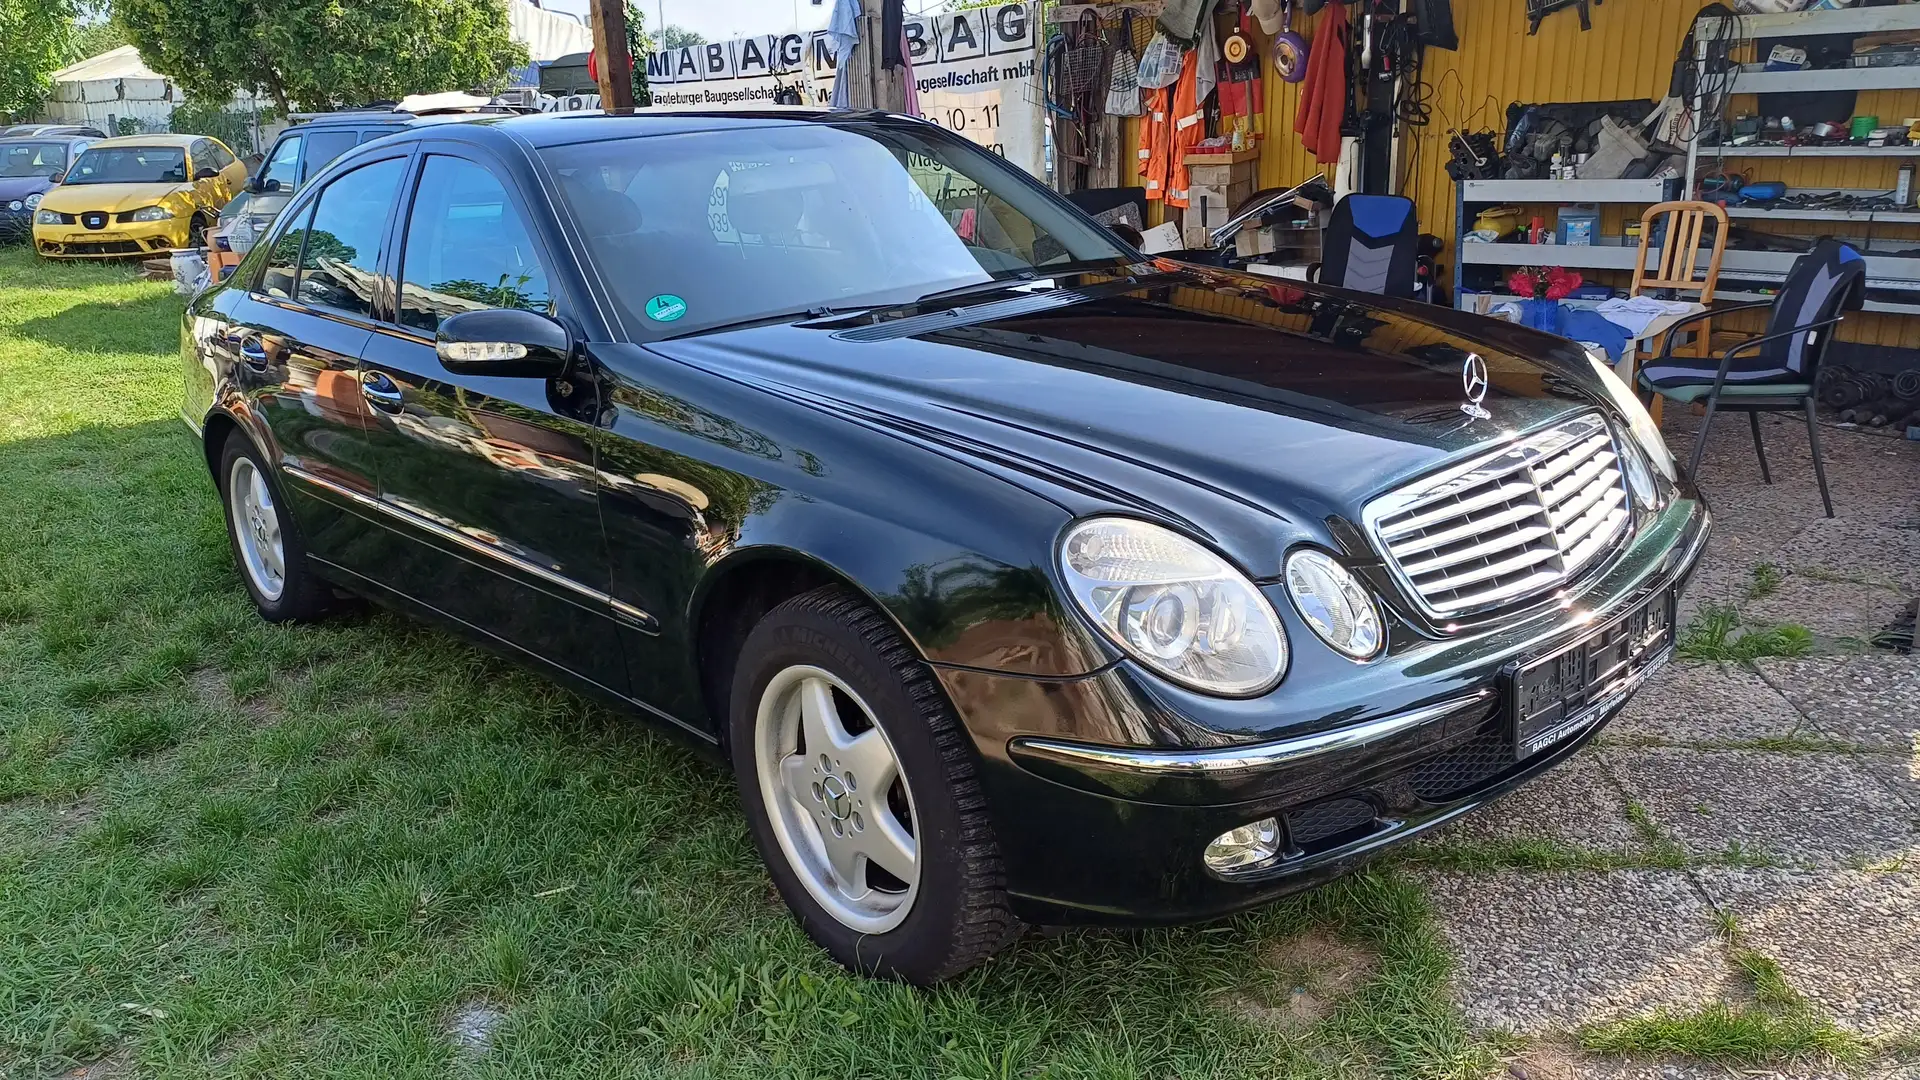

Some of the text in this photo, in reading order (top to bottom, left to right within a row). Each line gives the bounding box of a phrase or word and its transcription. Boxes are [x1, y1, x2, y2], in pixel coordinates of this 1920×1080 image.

[648, 34, 803, 77] MABAG
[1003, 59, 1035, 80] mbH
[946, 108, 965, 131] 10
[982, 104, 1000, 128] 11
[1557, 713, 1595, 740] Automobile
